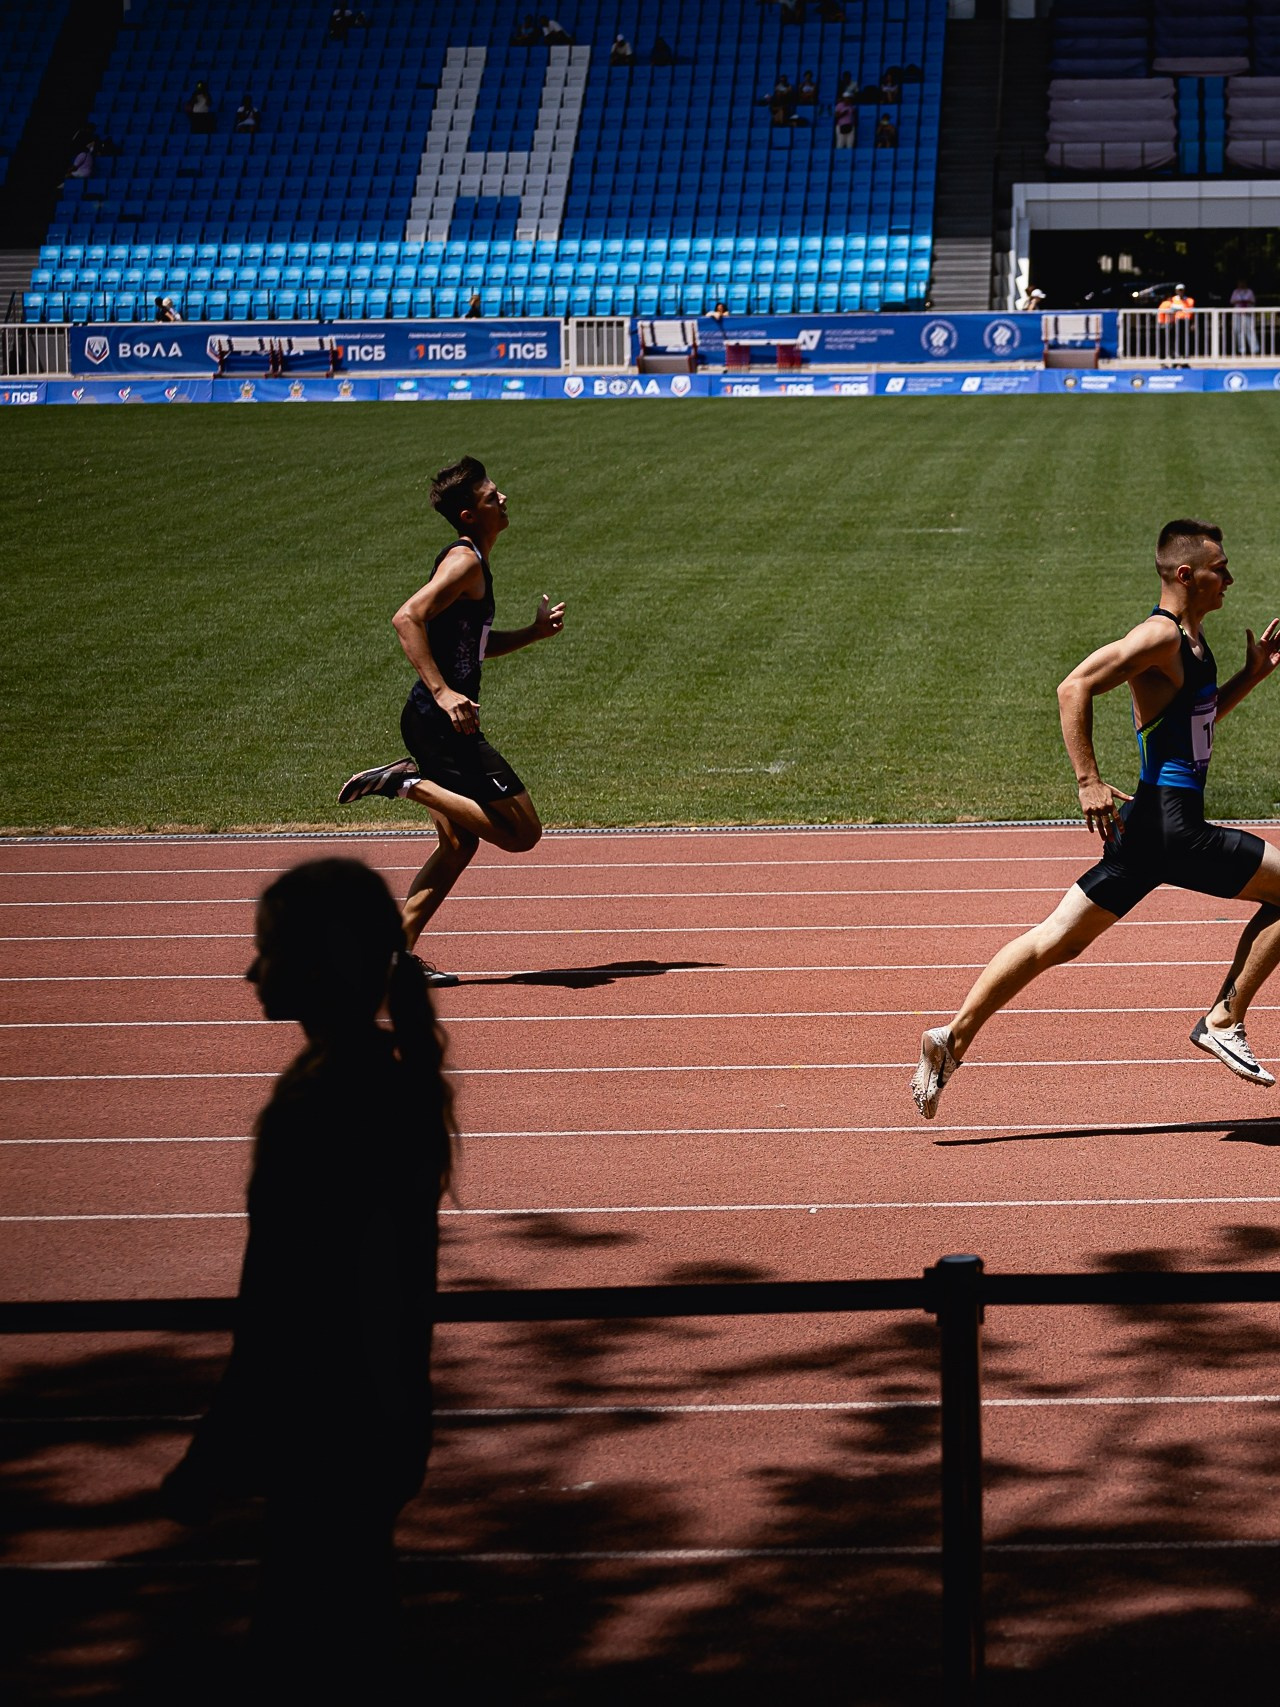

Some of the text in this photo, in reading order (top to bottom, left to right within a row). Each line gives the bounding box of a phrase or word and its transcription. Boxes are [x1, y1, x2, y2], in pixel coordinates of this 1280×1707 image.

[118, 342, 183, 359] ВФЛА
[347, 345, 386, 361] ПСБ
[428, 344, 467, 360] ПСБ
[509, 343, 548, 359] ПСБ
[593, 379, 661, 395] ВФЛА
[732, 384, 760, 396] ПСБ
[787, 383, 815, 395] ПСБ
[841, 382, 869, 395] ПСБ
[12, 391, 38, 403] ПСБ
